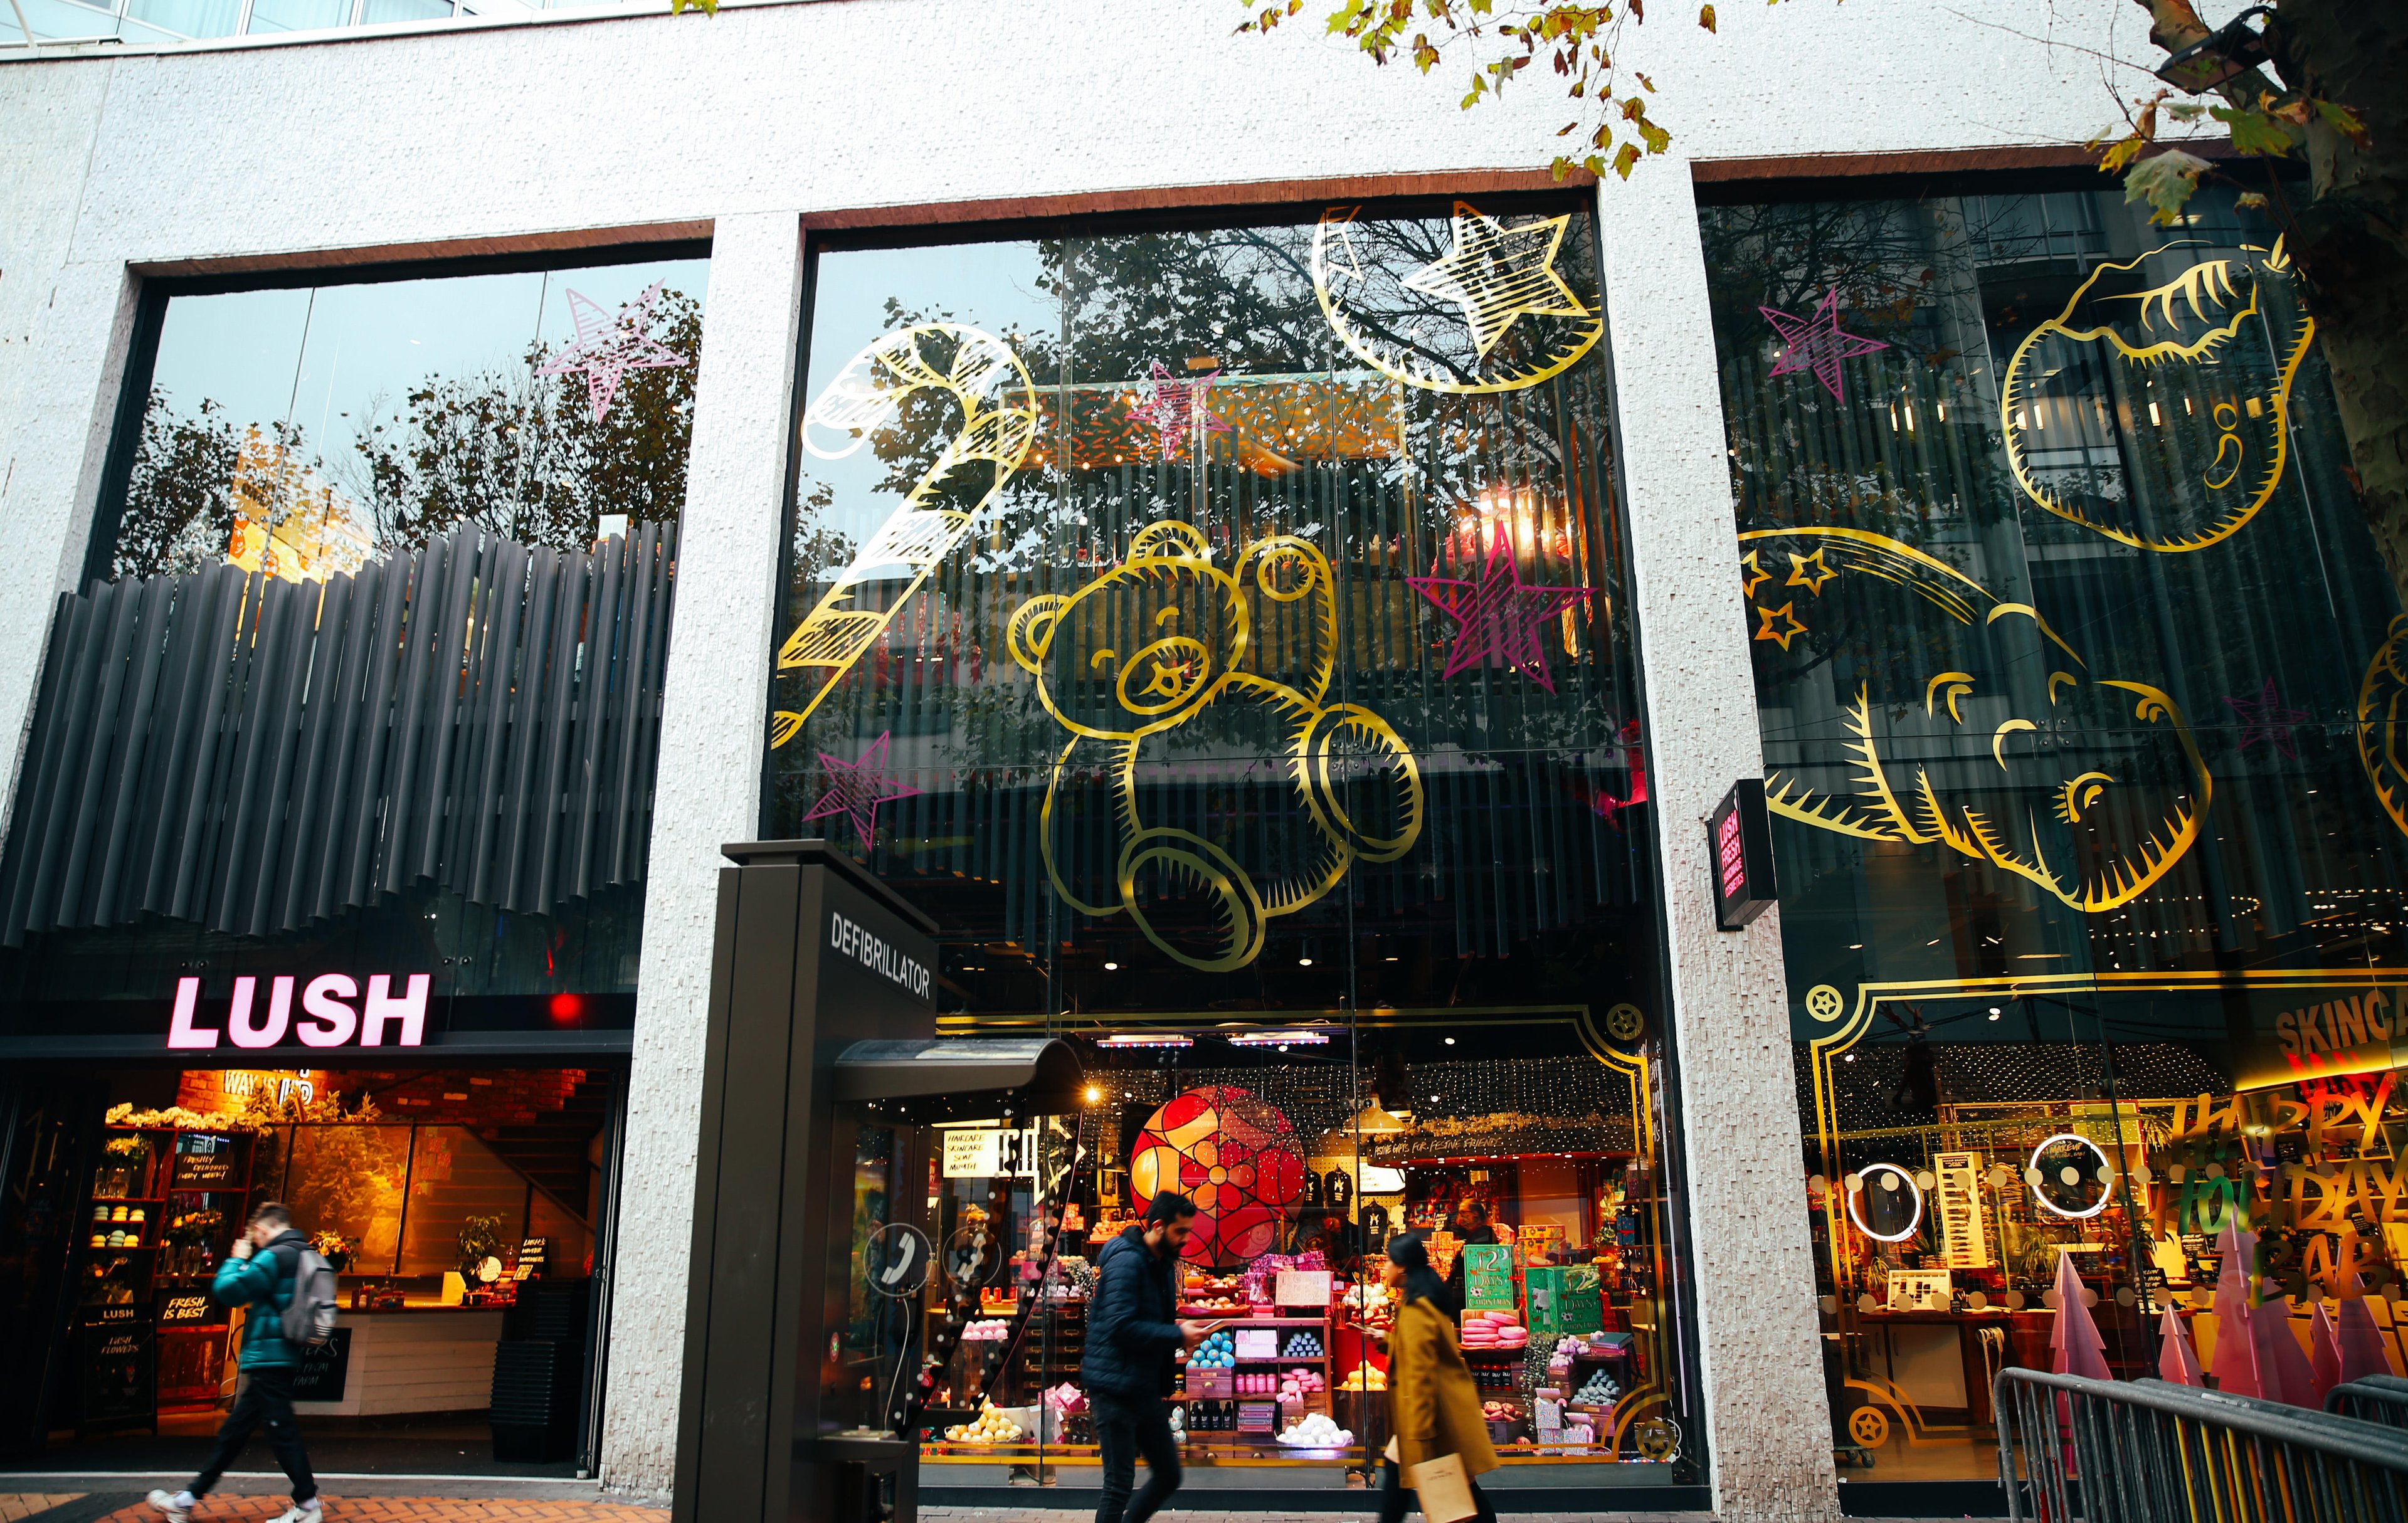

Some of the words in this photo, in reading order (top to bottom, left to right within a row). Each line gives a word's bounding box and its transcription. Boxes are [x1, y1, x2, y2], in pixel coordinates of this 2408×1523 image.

[1719, 809, 1739, 849] LUSH
[1721, 833, 1741, 871] FRESH
[1723, 856, 1743, 885] HANDMADE
[1724, 871, 1745, 899] COSMETICS
[832, 912, 930, 1000] DEFIBRILLATOR
[167, 973, 431, 1049] LUSH
[224, 1069, 259, 1095] WAY
[2171, 1072, 2398, 1164] HAPPY
[946, 1144, 983, 1152] SKINCARE
[948, 1134, 985, 1142] HAIRCARE
[1375, 1144, 1391, 1157] FESTIVE
[1392, 1142, 1410, 1154] GIFTS
[1412, 1141, 1427, 1153] FOR
[1430, 1138, 1461, 1154] FESTIVE
[1464, 1136, 1503, 1149] FRIENDS
[2050, 1142, 2083, 1152] MAKEUP
[183, 1155, 214, 1164] FRESHLY
[1476, 1250, 1500, 1272] 12
[2245, 1231, 2390, 1309] BAB
[1474, 1273, 1503, 1287] DAYS
[1568, 1273, 1589, 1296] 12
[163, 1309, 174, 1320] IS
[177, 1305, 208, 1319] BEST
[168, 1296, 205, 1308] FRESH
[1469, 1297, 1511, 1307] CHRISTMAS
[1565, 1298, 1593, 1311] DAYS
[103, 1309, 134, 1319] LUSH
[101, 1345, 139, 1355] FLOWERS
